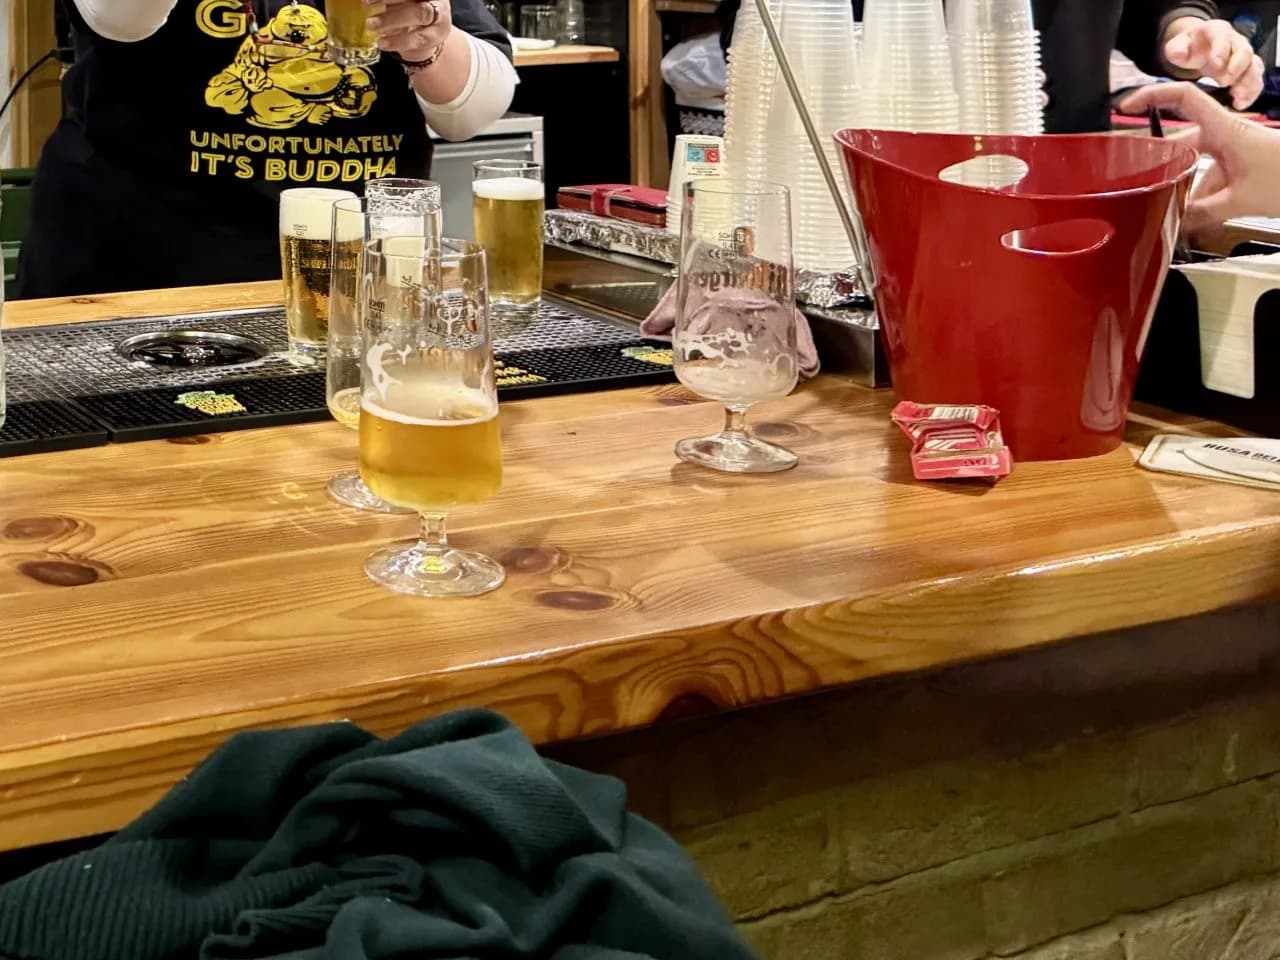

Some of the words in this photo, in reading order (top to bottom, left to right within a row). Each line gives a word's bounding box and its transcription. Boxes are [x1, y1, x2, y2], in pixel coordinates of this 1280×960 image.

[190, 130, 405, 155] UNFORTUNATELY
[190, 151, 255, 180] IT'S
[265, 155, 397, 183] BUDDHA
